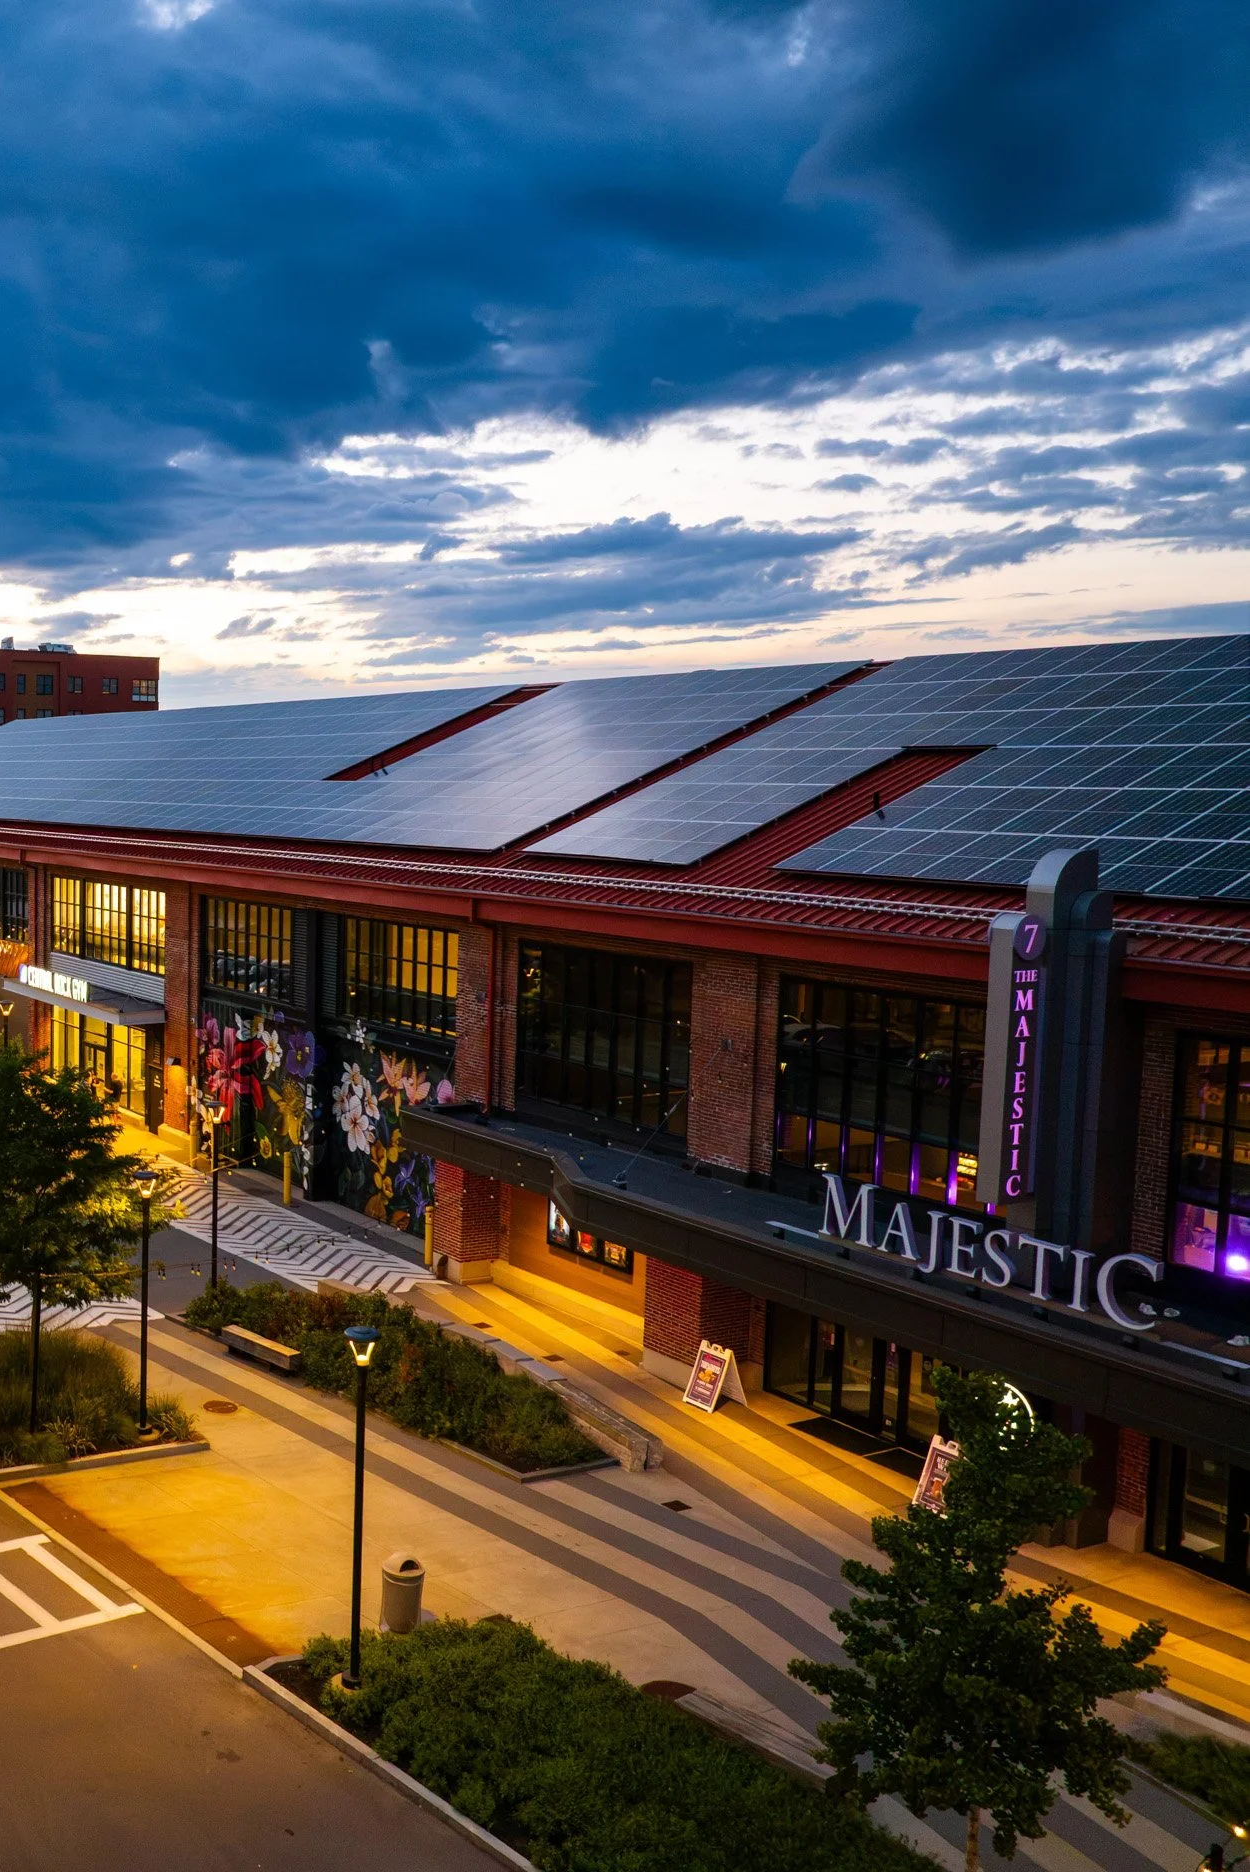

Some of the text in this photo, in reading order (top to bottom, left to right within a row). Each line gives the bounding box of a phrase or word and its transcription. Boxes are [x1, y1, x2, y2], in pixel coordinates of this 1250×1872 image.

[1014, 969, 1039, 984] THE
[1023, 924, 1039, 954] 7
[1005, 988, 1035, 1198] MAJESTIC
[818, 1172, 1164, 1331] MAJESTIC
